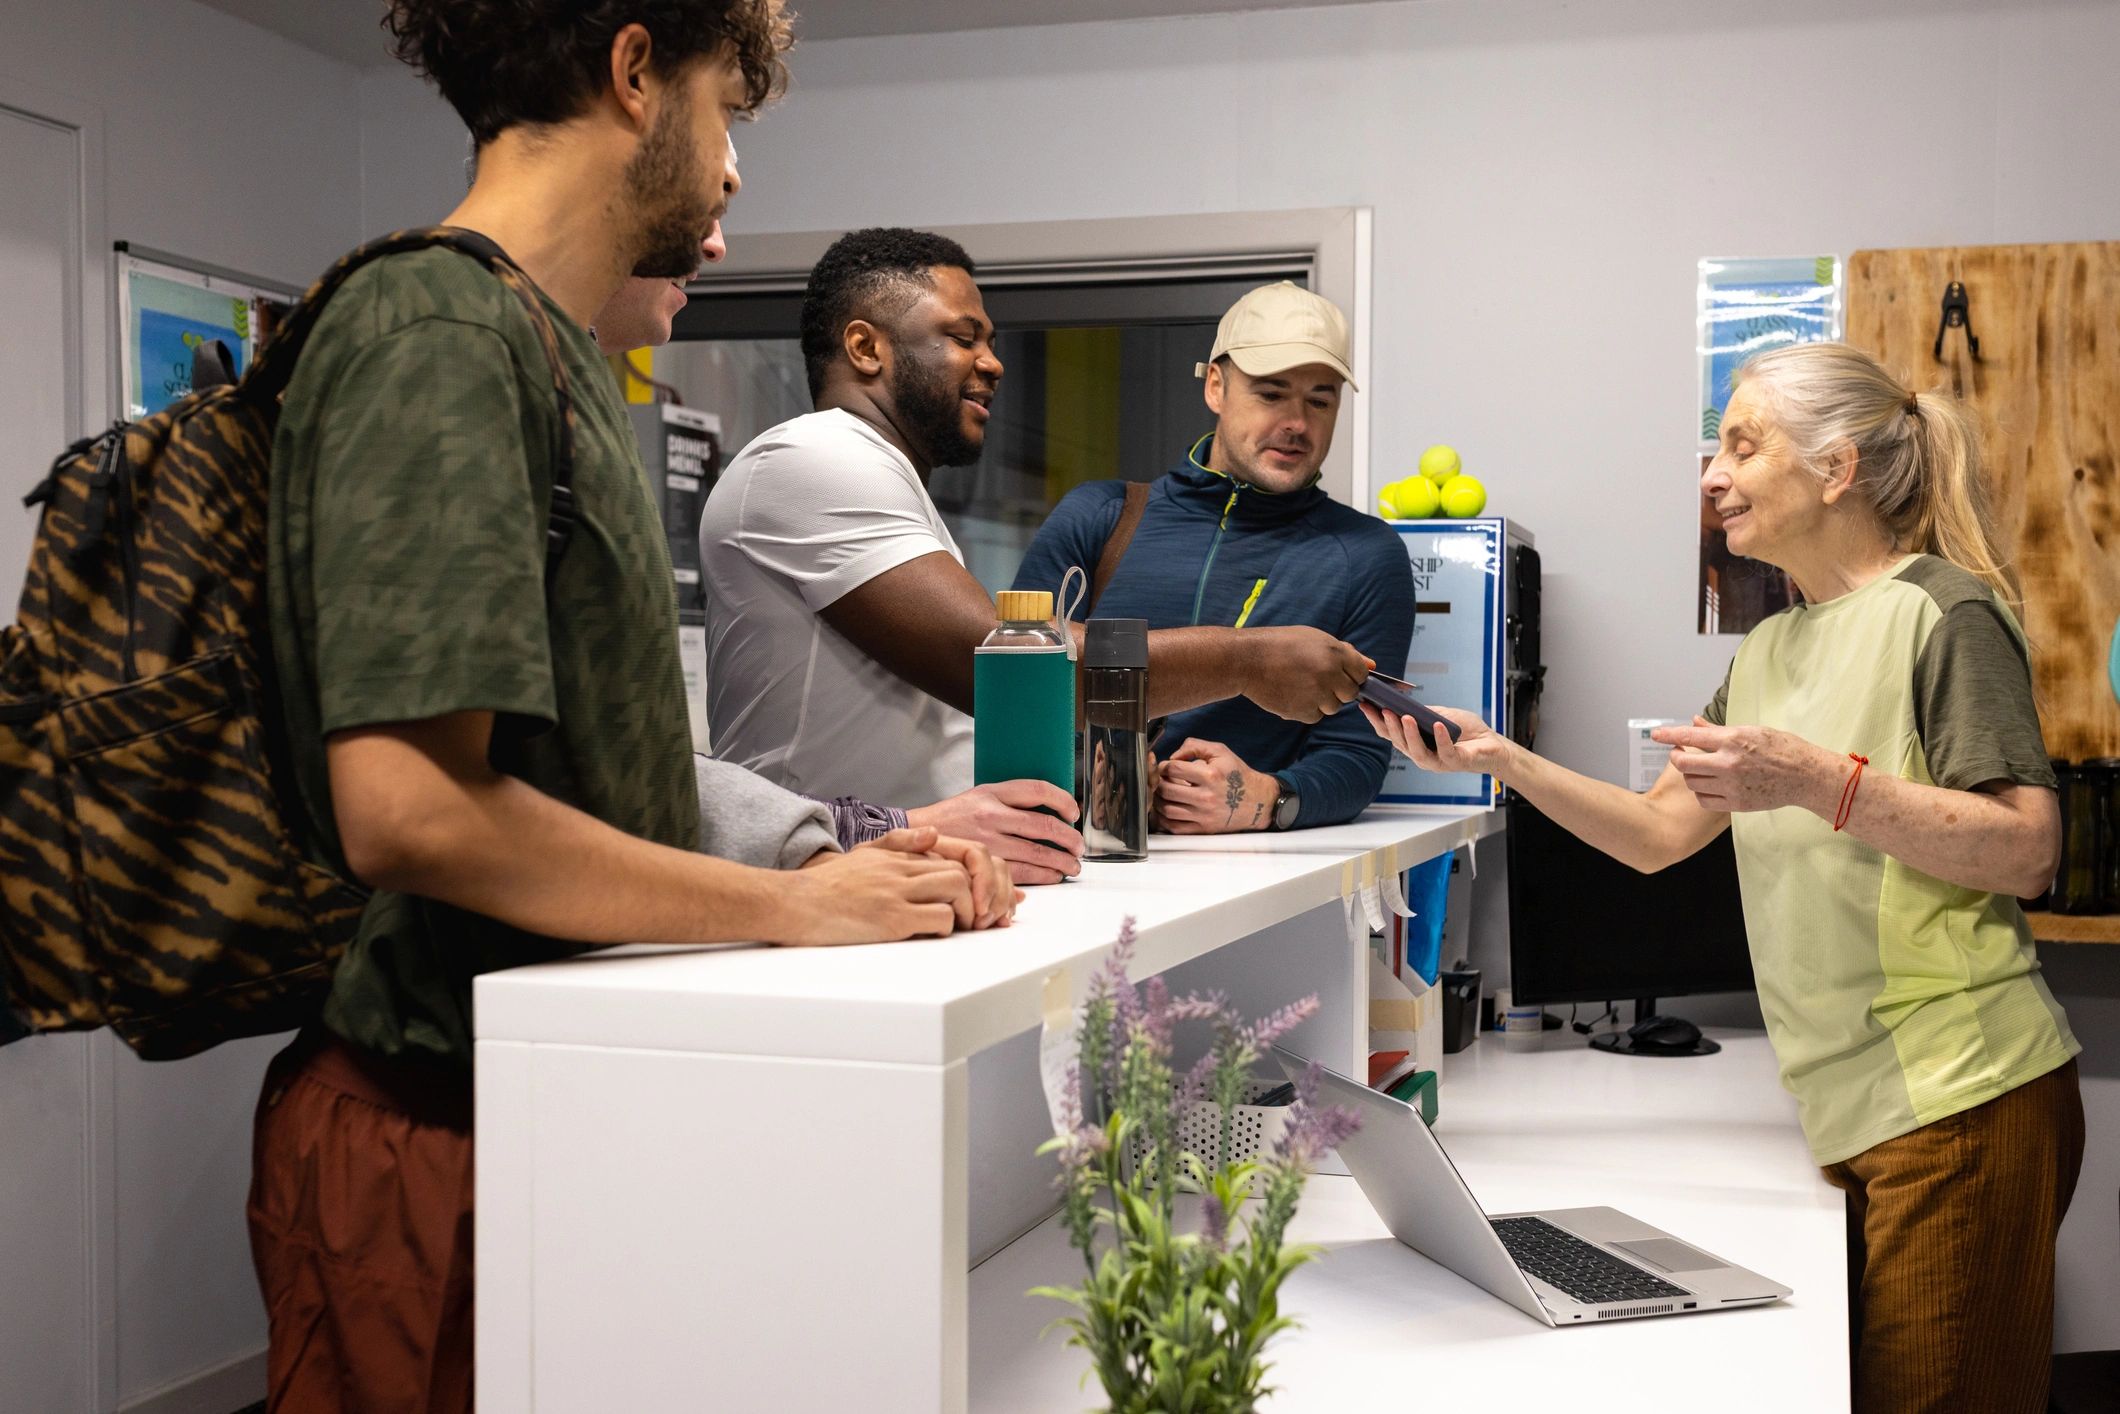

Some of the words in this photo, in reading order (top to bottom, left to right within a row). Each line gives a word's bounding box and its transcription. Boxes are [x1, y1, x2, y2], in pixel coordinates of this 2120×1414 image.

[667, 434, 711, 460] DRINKS
[1410, 557, 1444, 573] SHIP
[1413, 574, 1434, 591] ST
